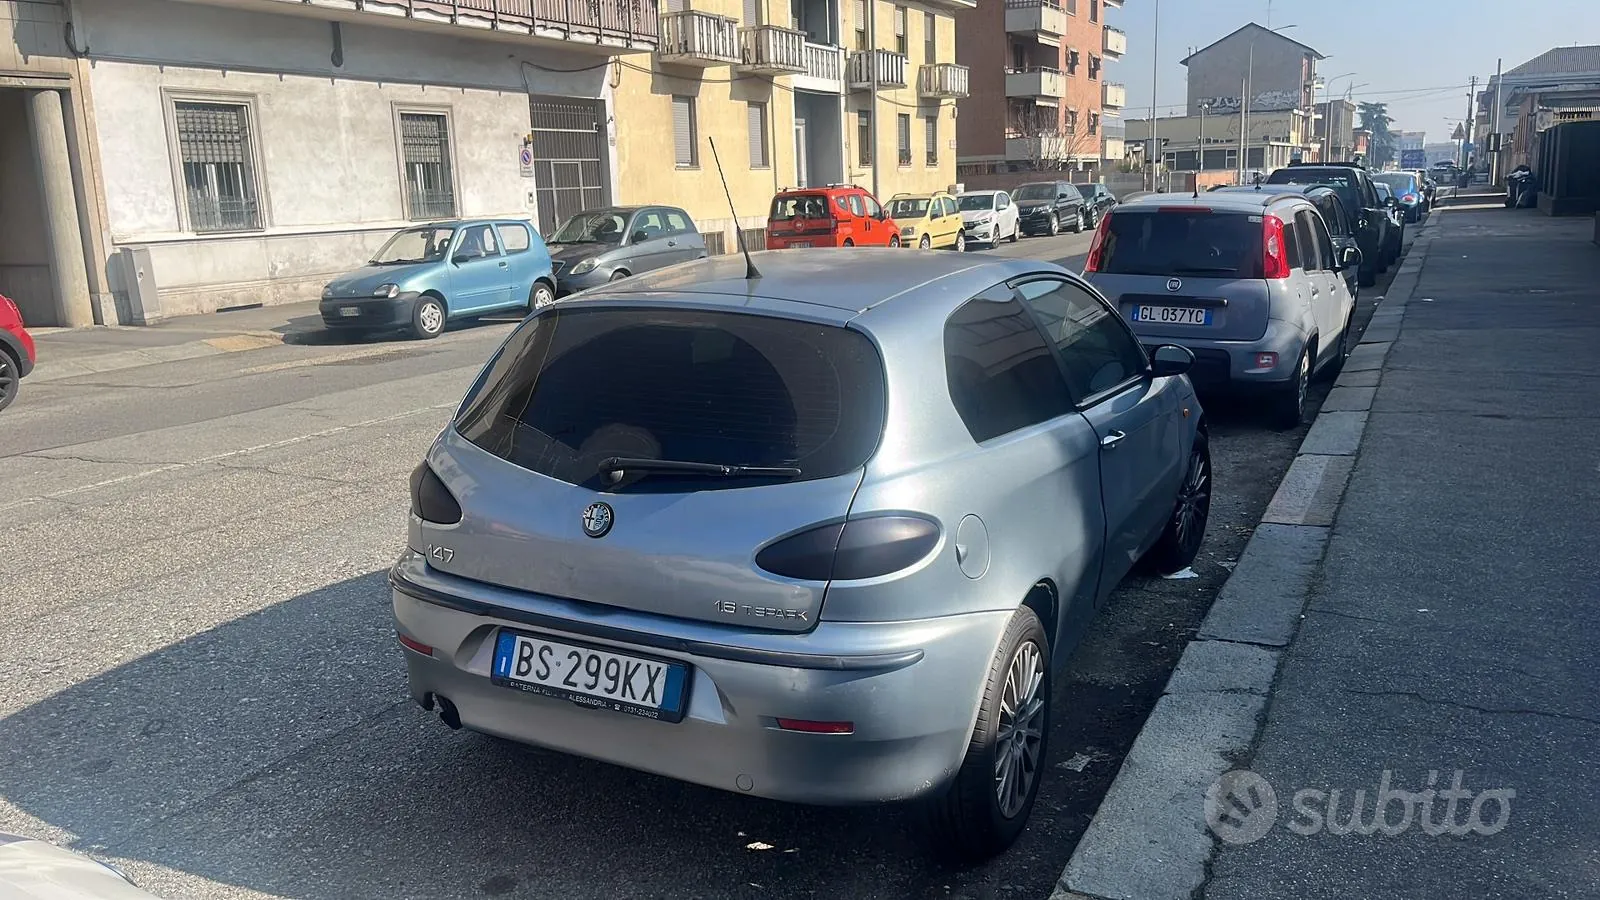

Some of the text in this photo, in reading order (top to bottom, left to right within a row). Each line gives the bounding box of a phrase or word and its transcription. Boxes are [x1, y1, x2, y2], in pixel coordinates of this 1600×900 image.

[1140, 307, 1155, 320] GL
[1161, 308, 1204, 322] 037YC
[427, 543, 454, 563] 147
[714, 600, 736, 613] 1.6
[515, 640, 553, 681] BS
[562, 650, 662, 704] 299KX
[568, 694, 607, 707] ALESSANDRIA
